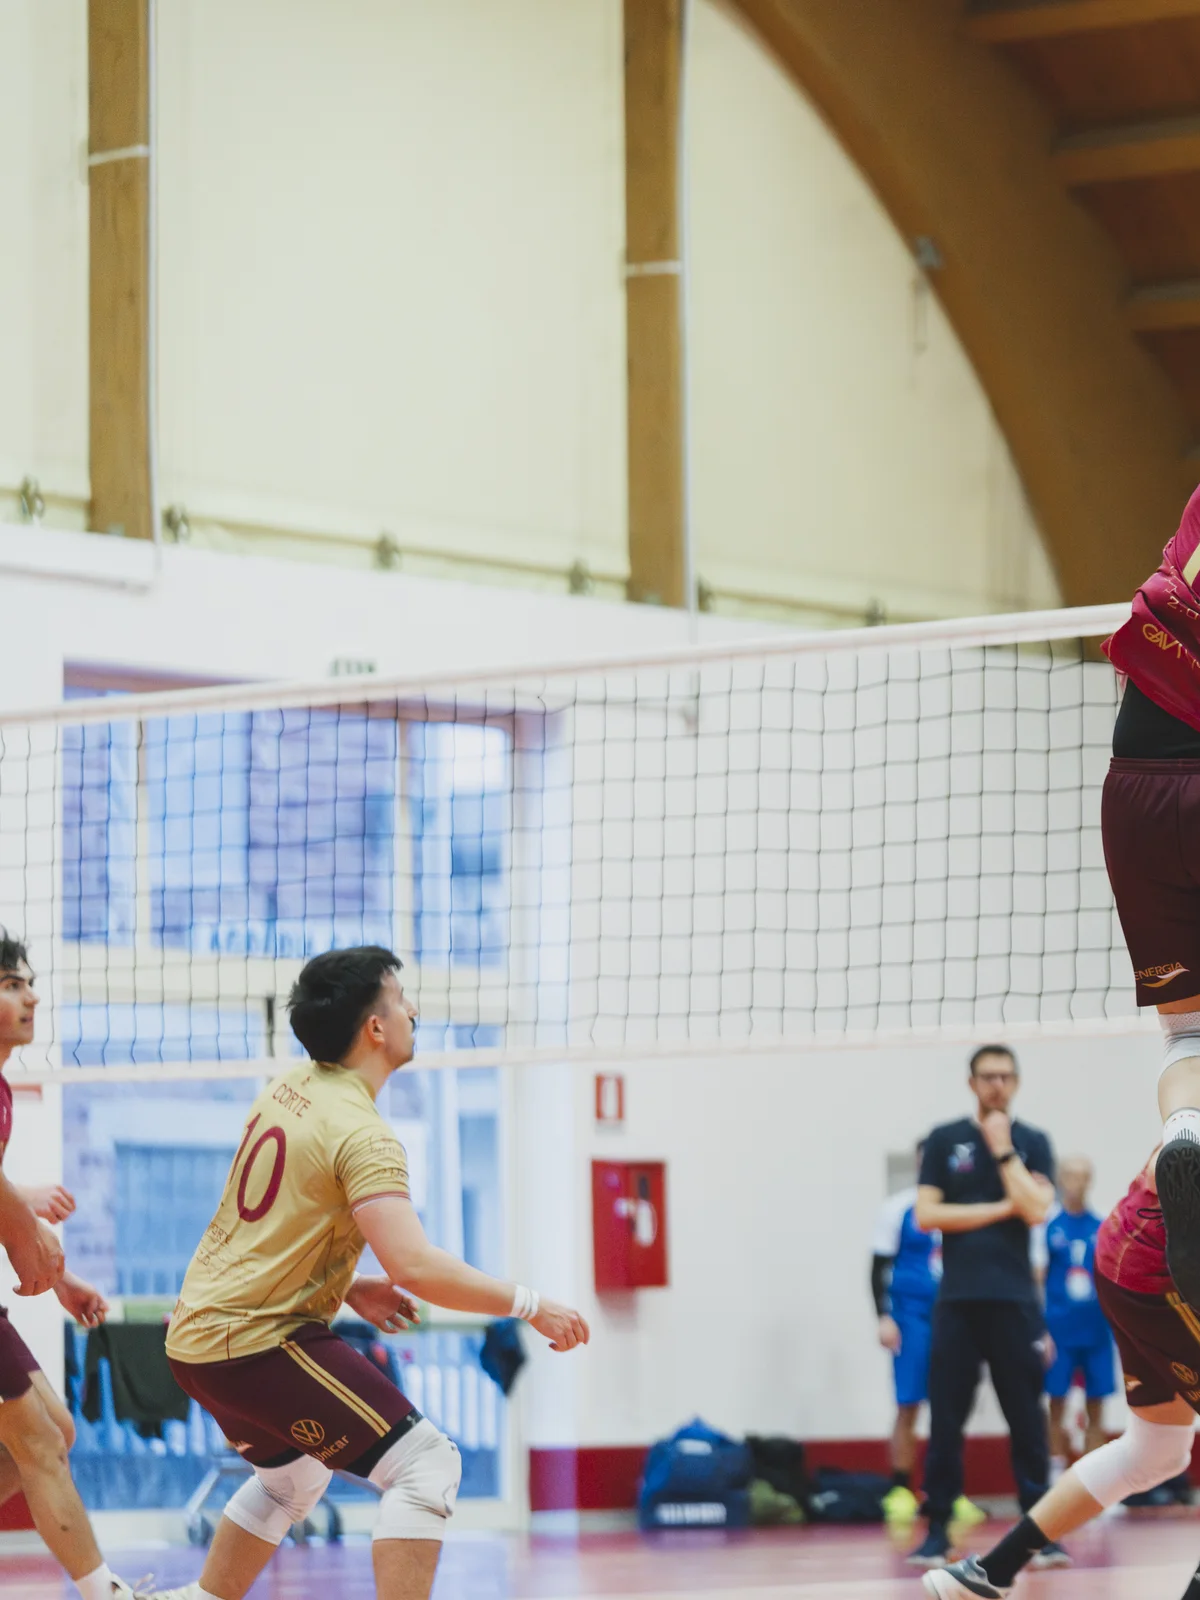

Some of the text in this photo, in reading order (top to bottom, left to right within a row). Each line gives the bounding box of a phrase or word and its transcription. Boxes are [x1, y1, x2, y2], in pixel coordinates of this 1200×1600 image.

[1134, 962, 1184, 982] ENERGIA
[272, 1083, 312, 1118] CORTE
[227, 1112, 287, 1223] 10
